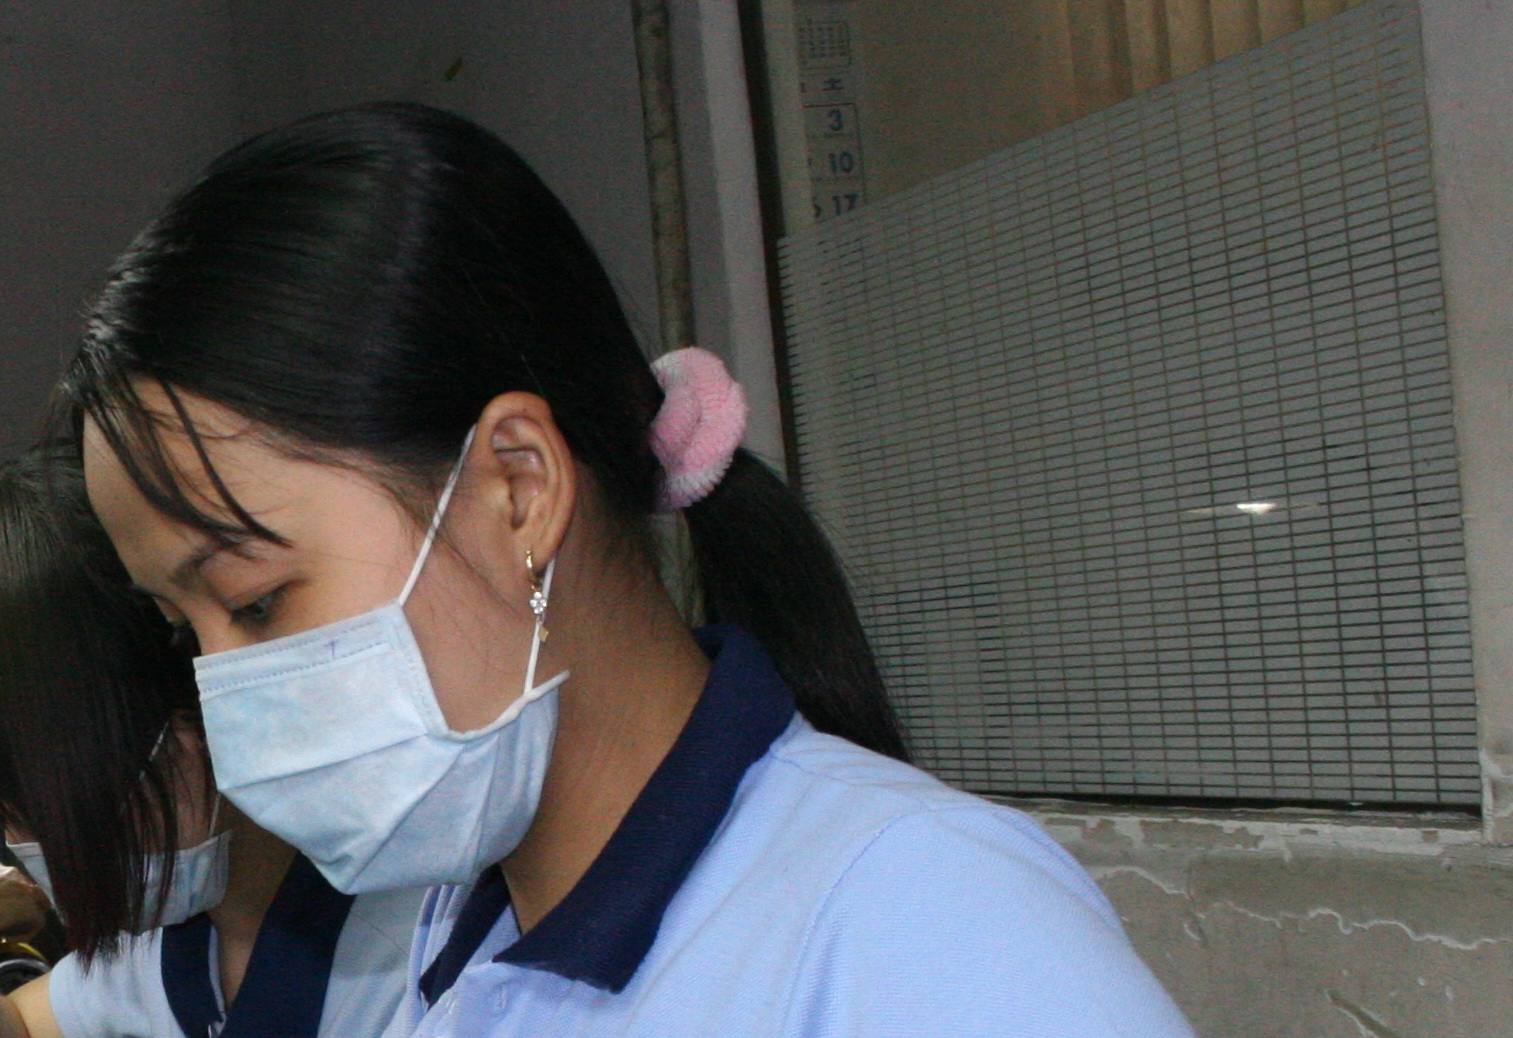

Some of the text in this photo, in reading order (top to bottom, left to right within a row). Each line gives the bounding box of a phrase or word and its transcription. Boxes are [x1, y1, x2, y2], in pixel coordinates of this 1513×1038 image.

[829, 109, 843, 131] 3
[829, 152, 854, 174] 10
[832, 193, 858, 216] 17
